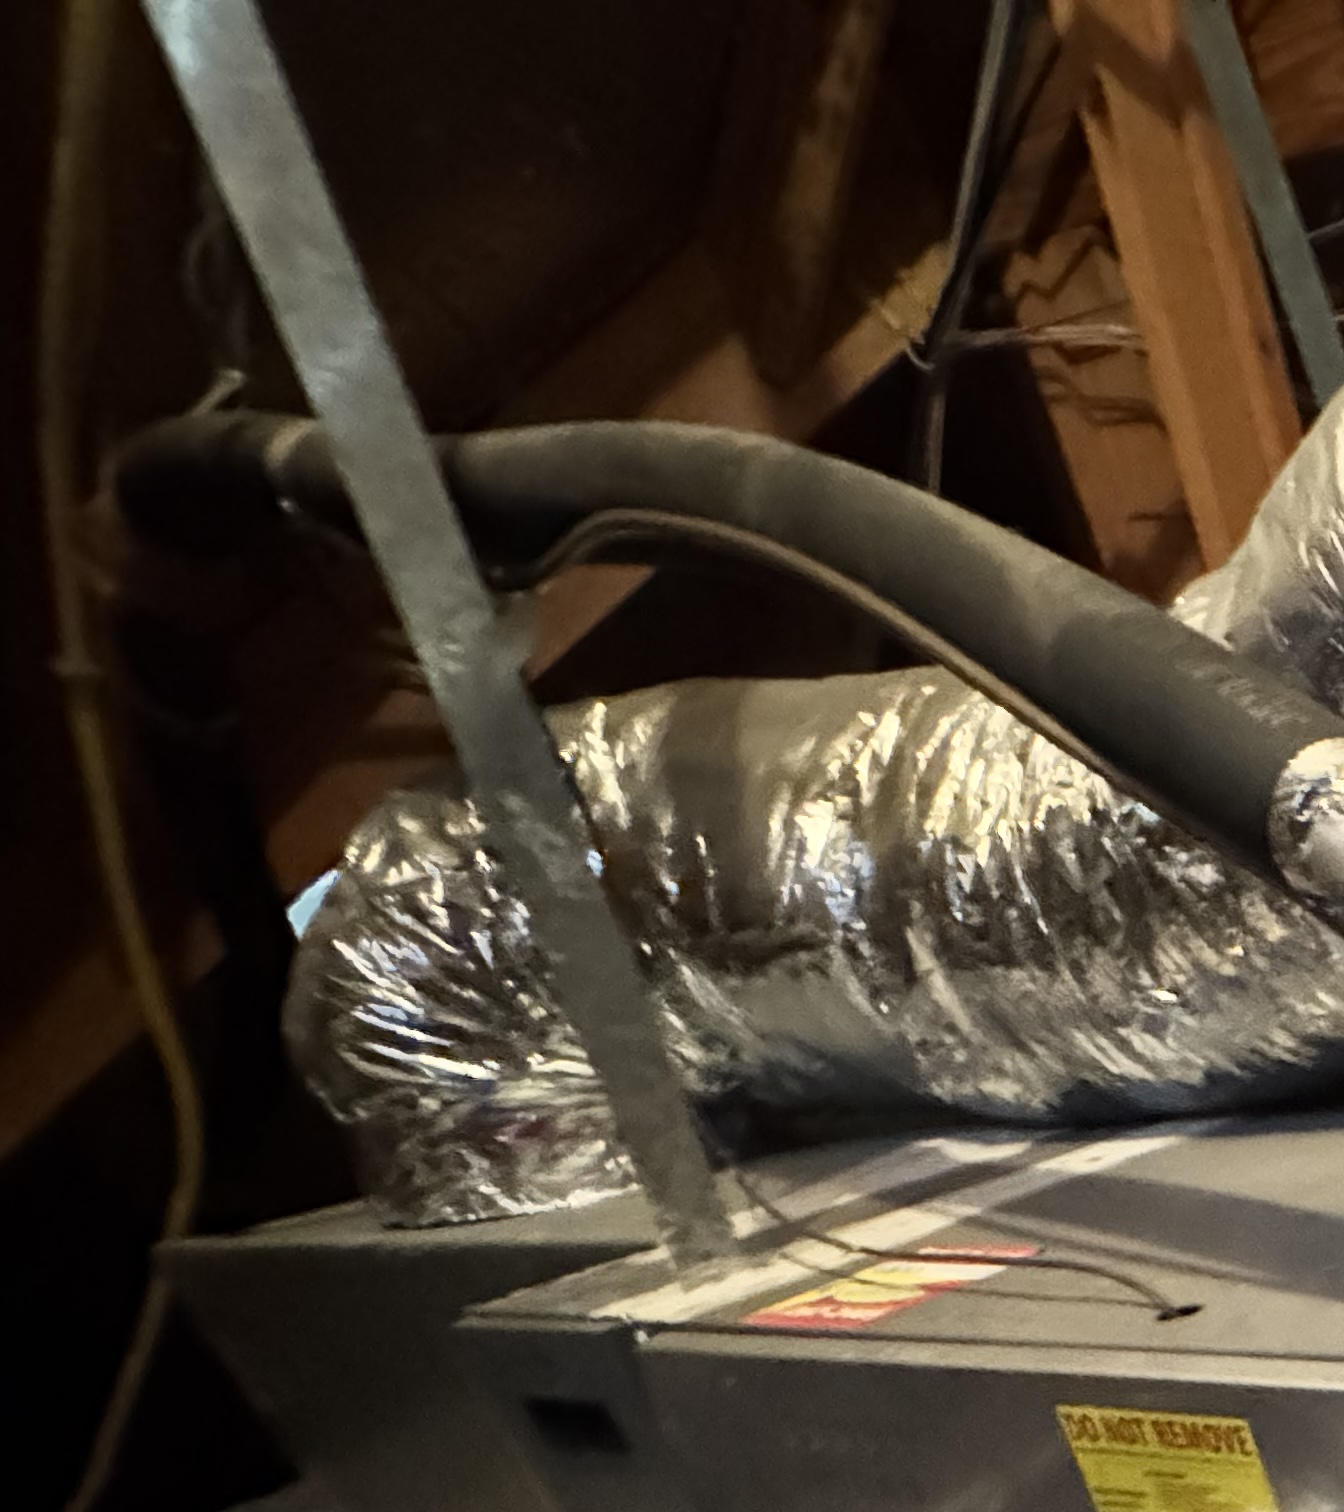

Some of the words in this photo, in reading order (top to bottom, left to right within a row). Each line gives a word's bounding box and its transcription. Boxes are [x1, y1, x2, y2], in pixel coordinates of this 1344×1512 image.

[1063, 1413, 1101, 1442] DO
[1101, 1416, 1149, 1445] NOT
[1151, 1419, 1253, 1456] REMOVE
